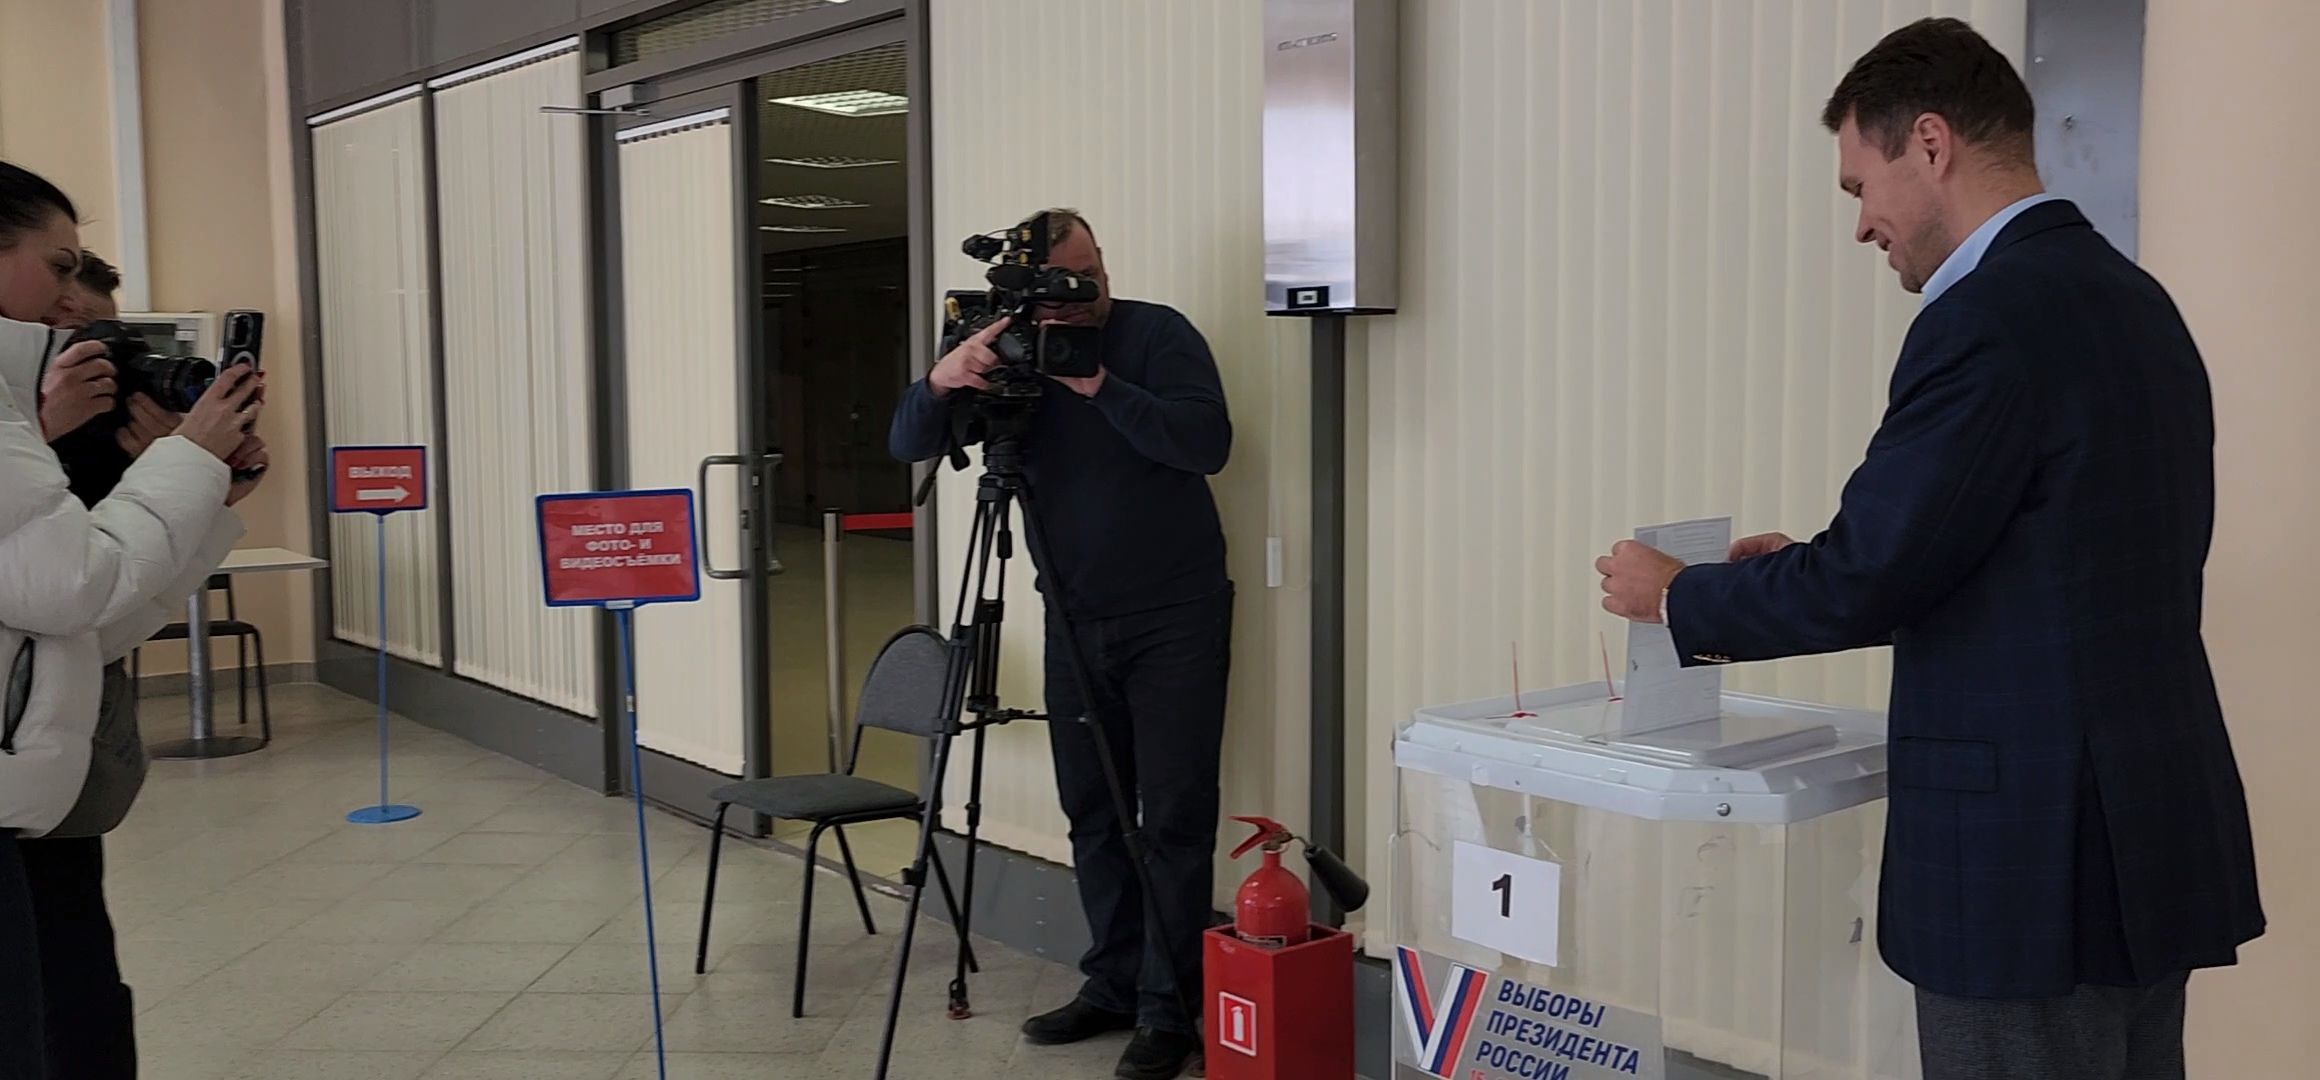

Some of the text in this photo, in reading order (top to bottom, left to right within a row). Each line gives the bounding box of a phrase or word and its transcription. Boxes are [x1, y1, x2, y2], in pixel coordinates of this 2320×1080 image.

[571, 521, 664, 536] МЕСТО ДЛЯ
[585, 538, 652, 551] ФОТО- И
[1492, 873, 1512, 918] 1
[1498, 980, 1606, 1028] ВЫБОРЫ
[1475, 1040, 1570, 1080] РОССИИ
[1486, 1010, 1641, 1075] ПРЕЗИДЕНТА
